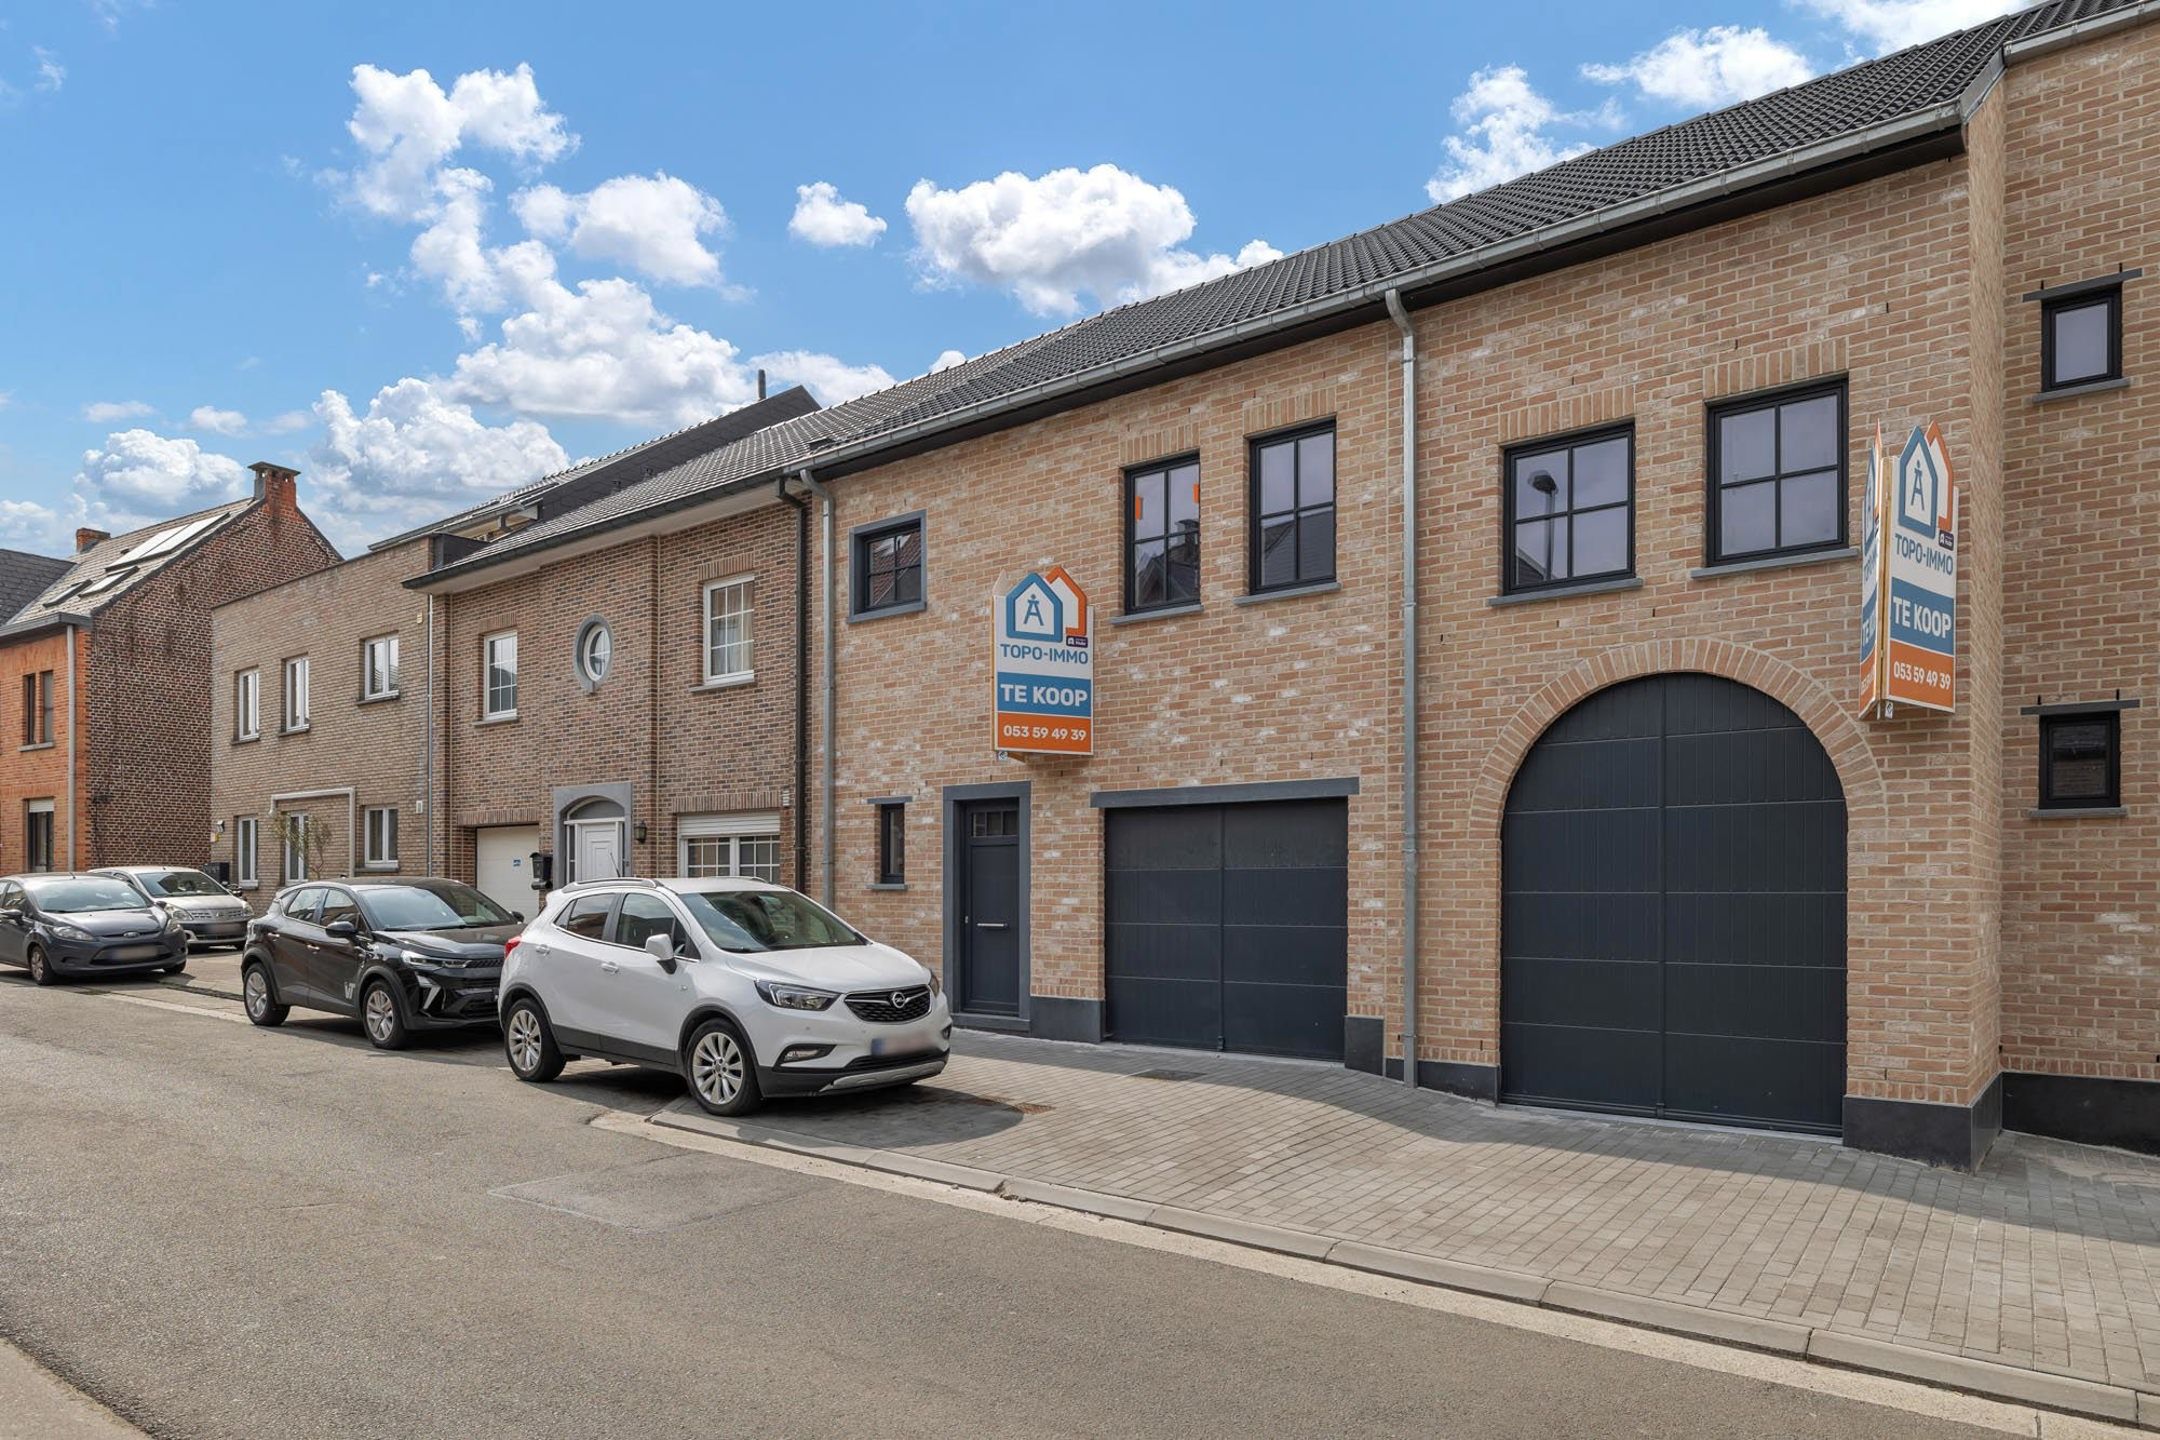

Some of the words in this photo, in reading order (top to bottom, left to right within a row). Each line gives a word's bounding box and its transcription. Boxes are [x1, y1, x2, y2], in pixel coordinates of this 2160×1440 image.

[1895, 533, 1953, 575] TOPO-IMMO
[1893, 596, 1911, 628] TE
[1914, 604, 1952, 639] KOOP
[1000, 643, 1088, 664] TOPO-IMMO
[1893, 661, 1912, 681] 053
[1913, 667, 1925, 684] 59
[1926, 670, 1938, 687] 49
[1939, 673, 1952, 690] 39
[1000, 684, 1027, 703] TE
[1033, 686, 1088, 706] KOOP
[1003, 725, 1029, 737] 053
[1033, 727, 1048, 738] 59
[1052, 728, 1068, 740] 49
[1071, 729, 1086, 741] 39
